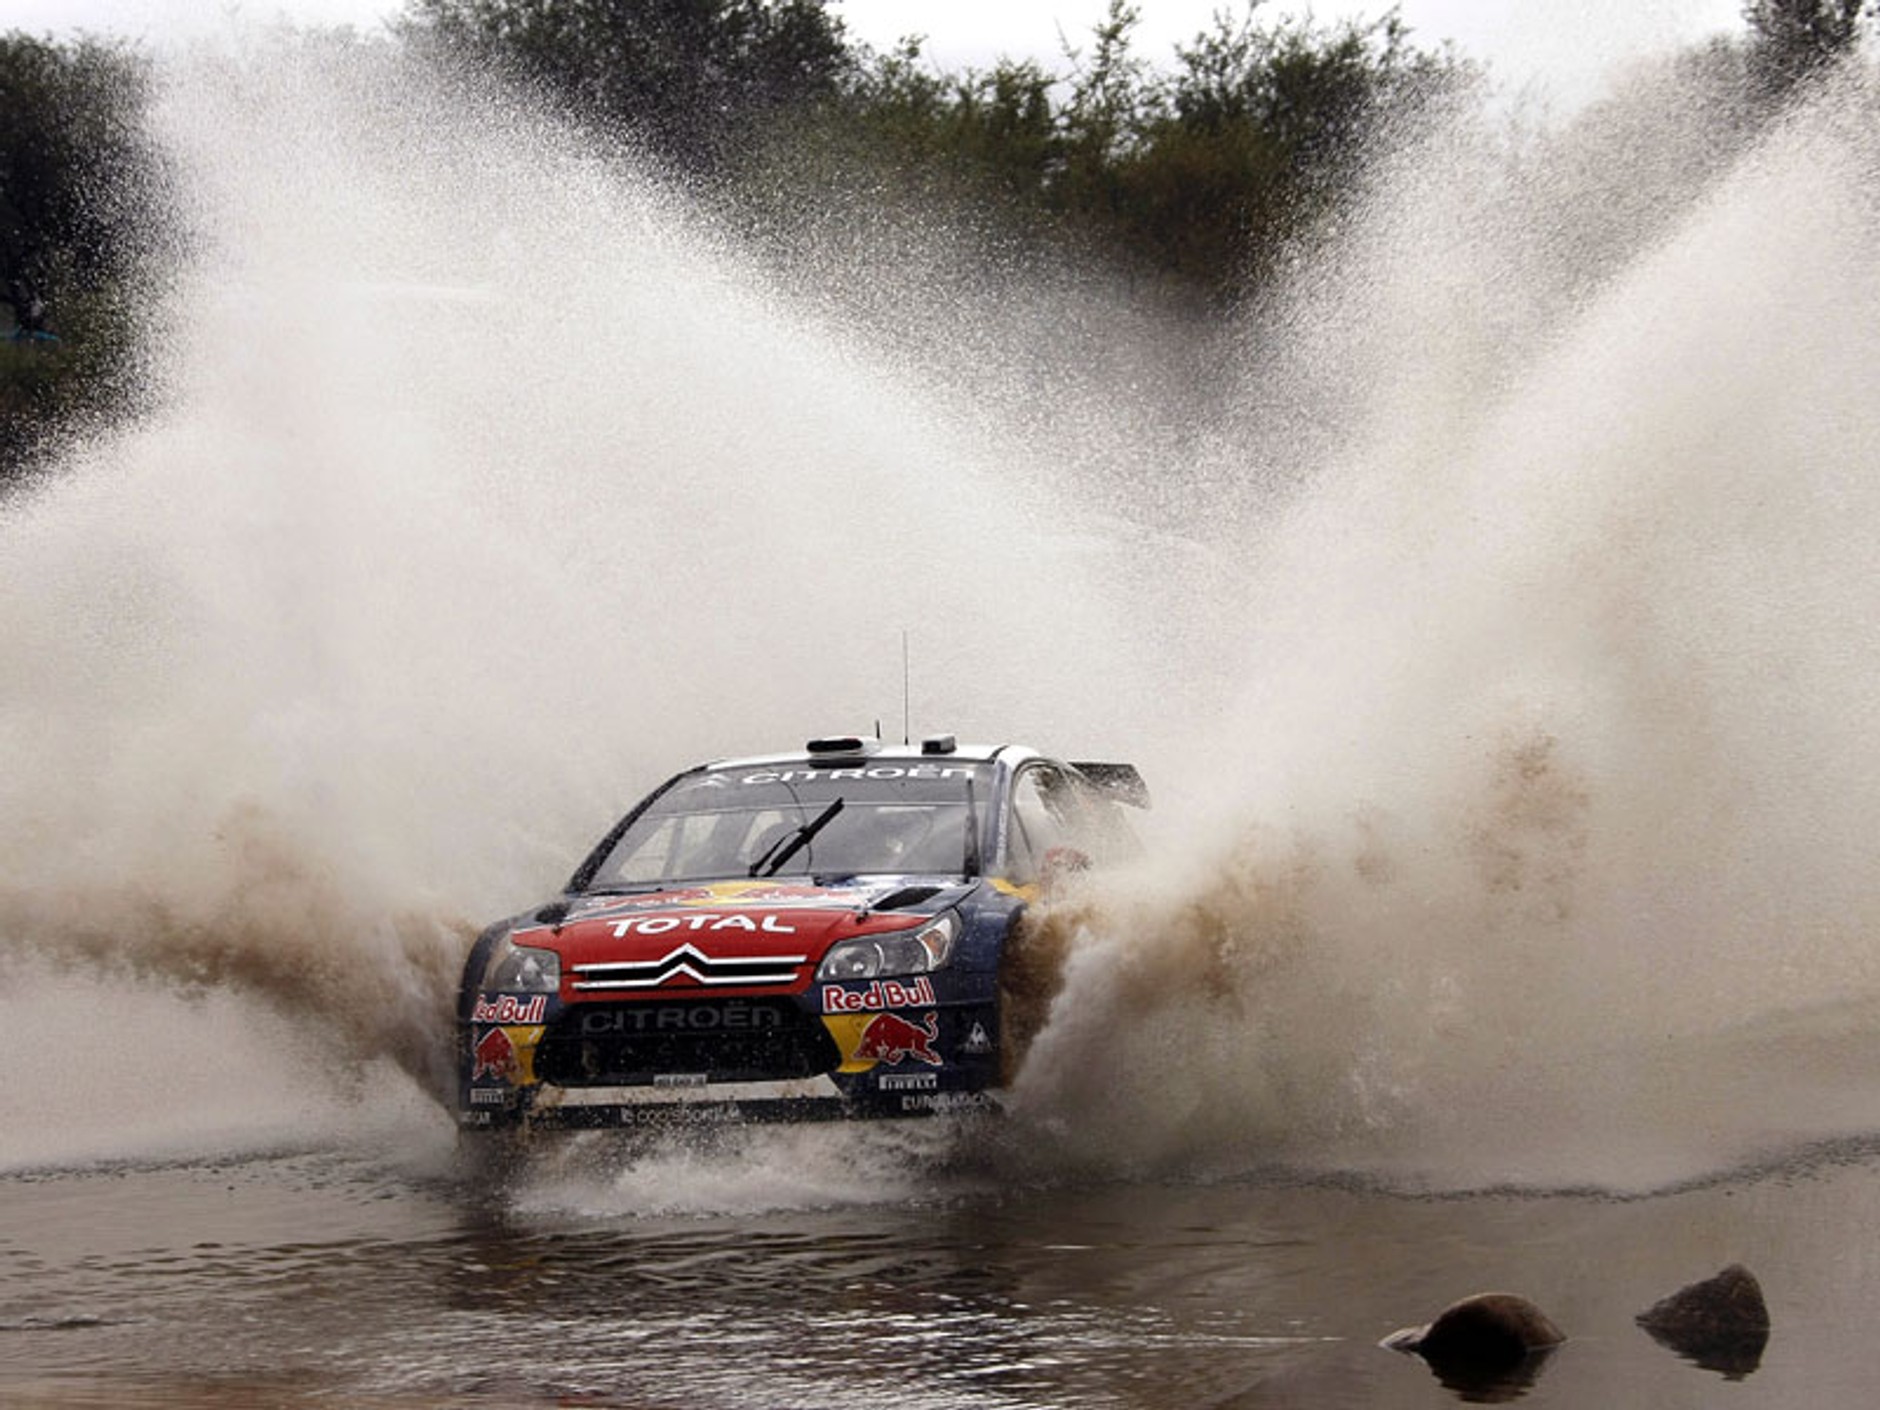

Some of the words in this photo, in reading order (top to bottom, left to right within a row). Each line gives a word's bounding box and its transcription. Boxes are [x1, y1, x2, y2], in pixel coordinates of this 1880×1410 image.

[606, 914, 796, 938] TOTAL
[822, 980, 883, 1013] Red
[883, 976, 936, 1008] Bull
[499, 995, 547, 1023] Bull
